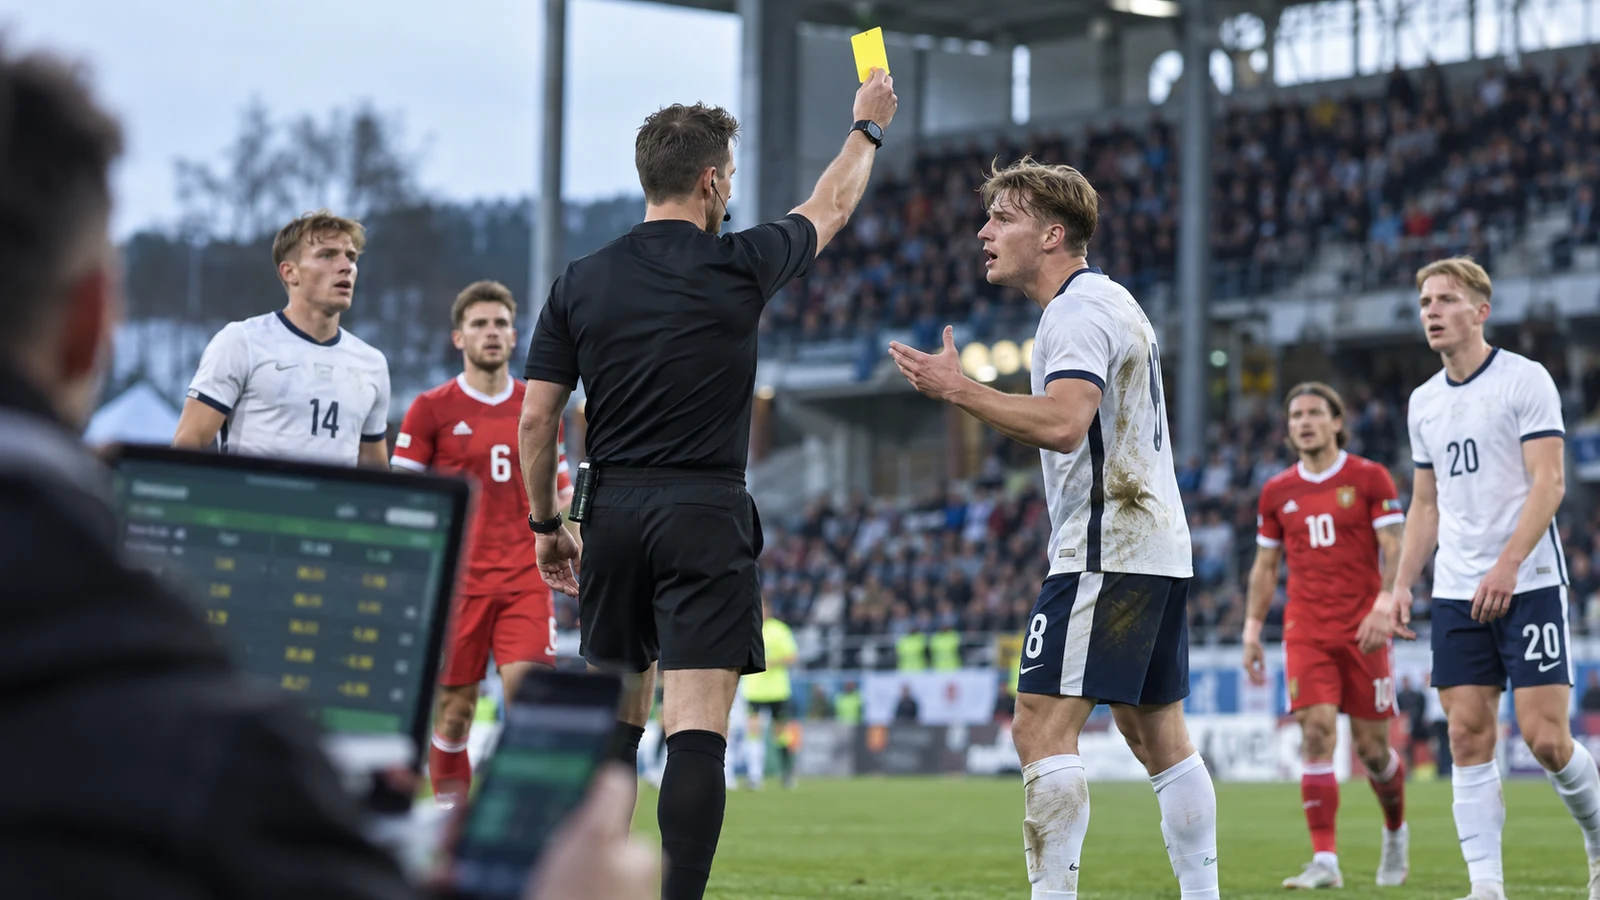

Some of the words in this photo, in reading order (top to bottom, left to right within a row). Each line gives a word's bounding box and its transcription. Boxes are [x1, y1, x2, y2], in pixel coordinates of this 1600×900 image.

[310, 398, 339, 439] 14
[490, 444, 512, 483] 6
[1447, 438, 1480, 478] 20
[1305, 513, 1337, 549] 10
[1025, 613, 1048, 659] 8
[1522, 622, 1560, 661] 20
